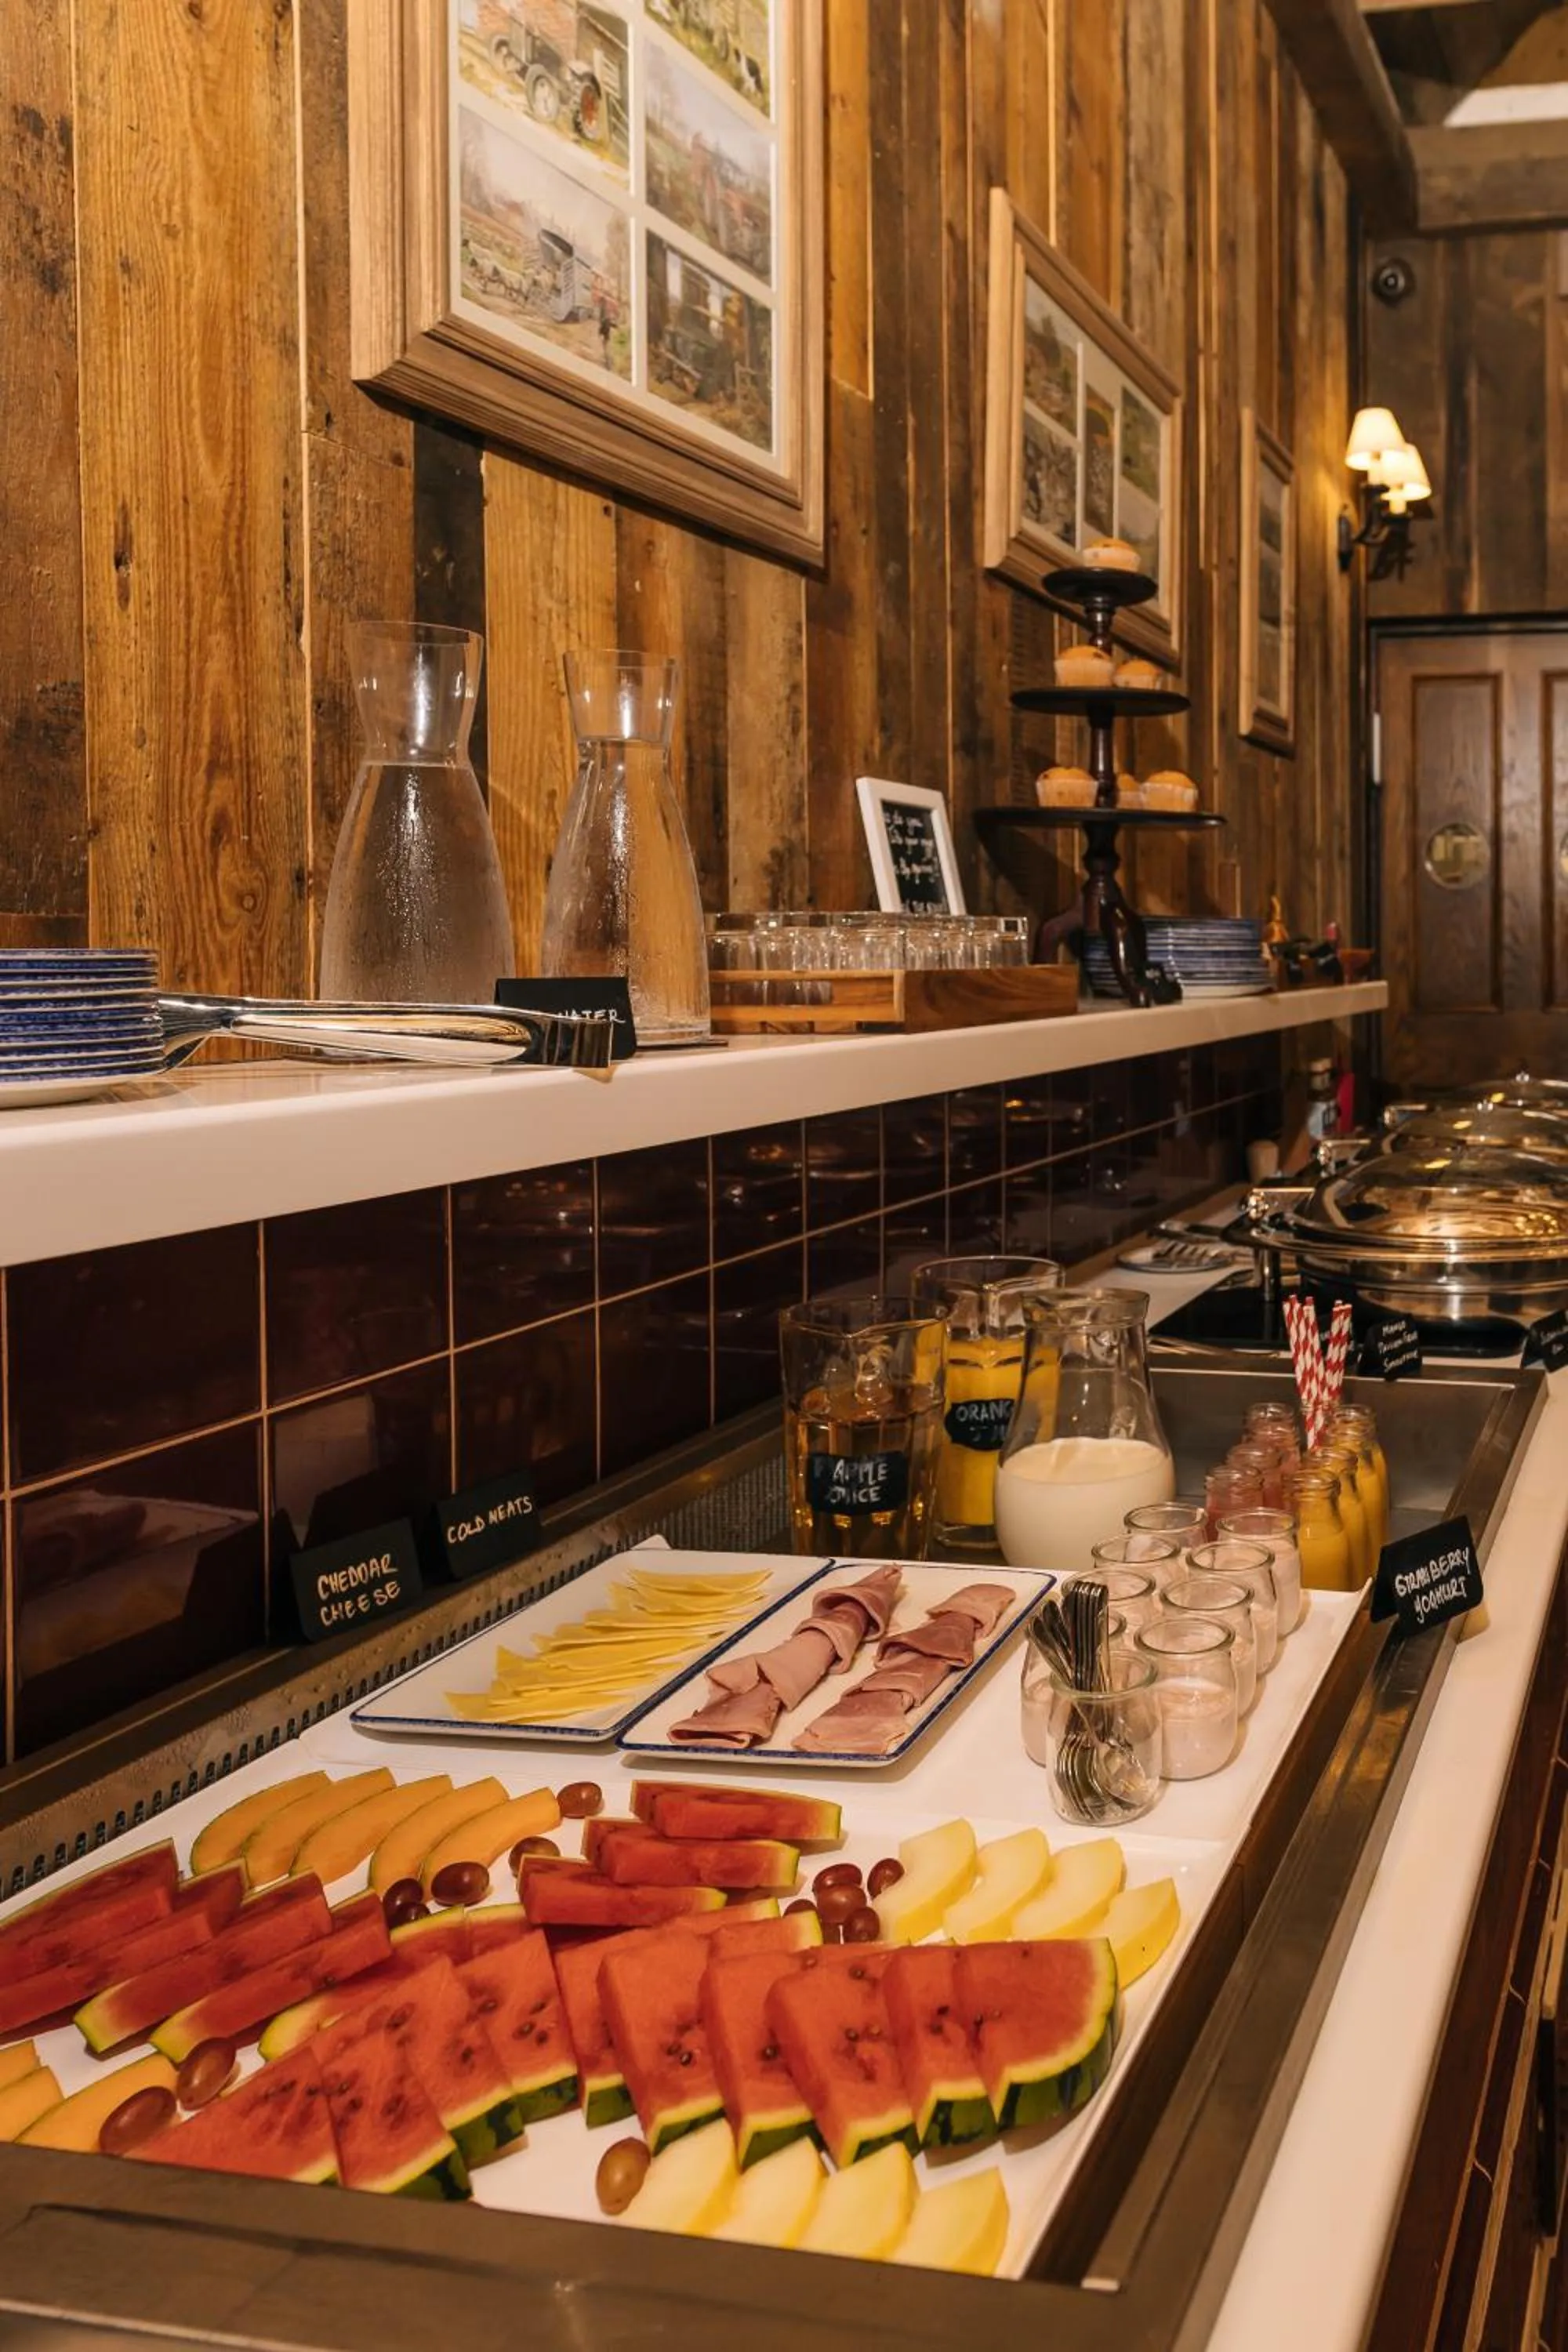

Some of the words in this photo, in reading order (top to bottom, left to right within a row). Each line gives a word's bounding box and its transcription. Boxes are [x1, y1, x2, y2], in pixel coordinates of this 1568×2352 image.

[447, 1515, 486, 1544] COLD
[317, 1553, 398, 1601] CHEDDAR
[320, 1580, 401, 1627] CHEESE
